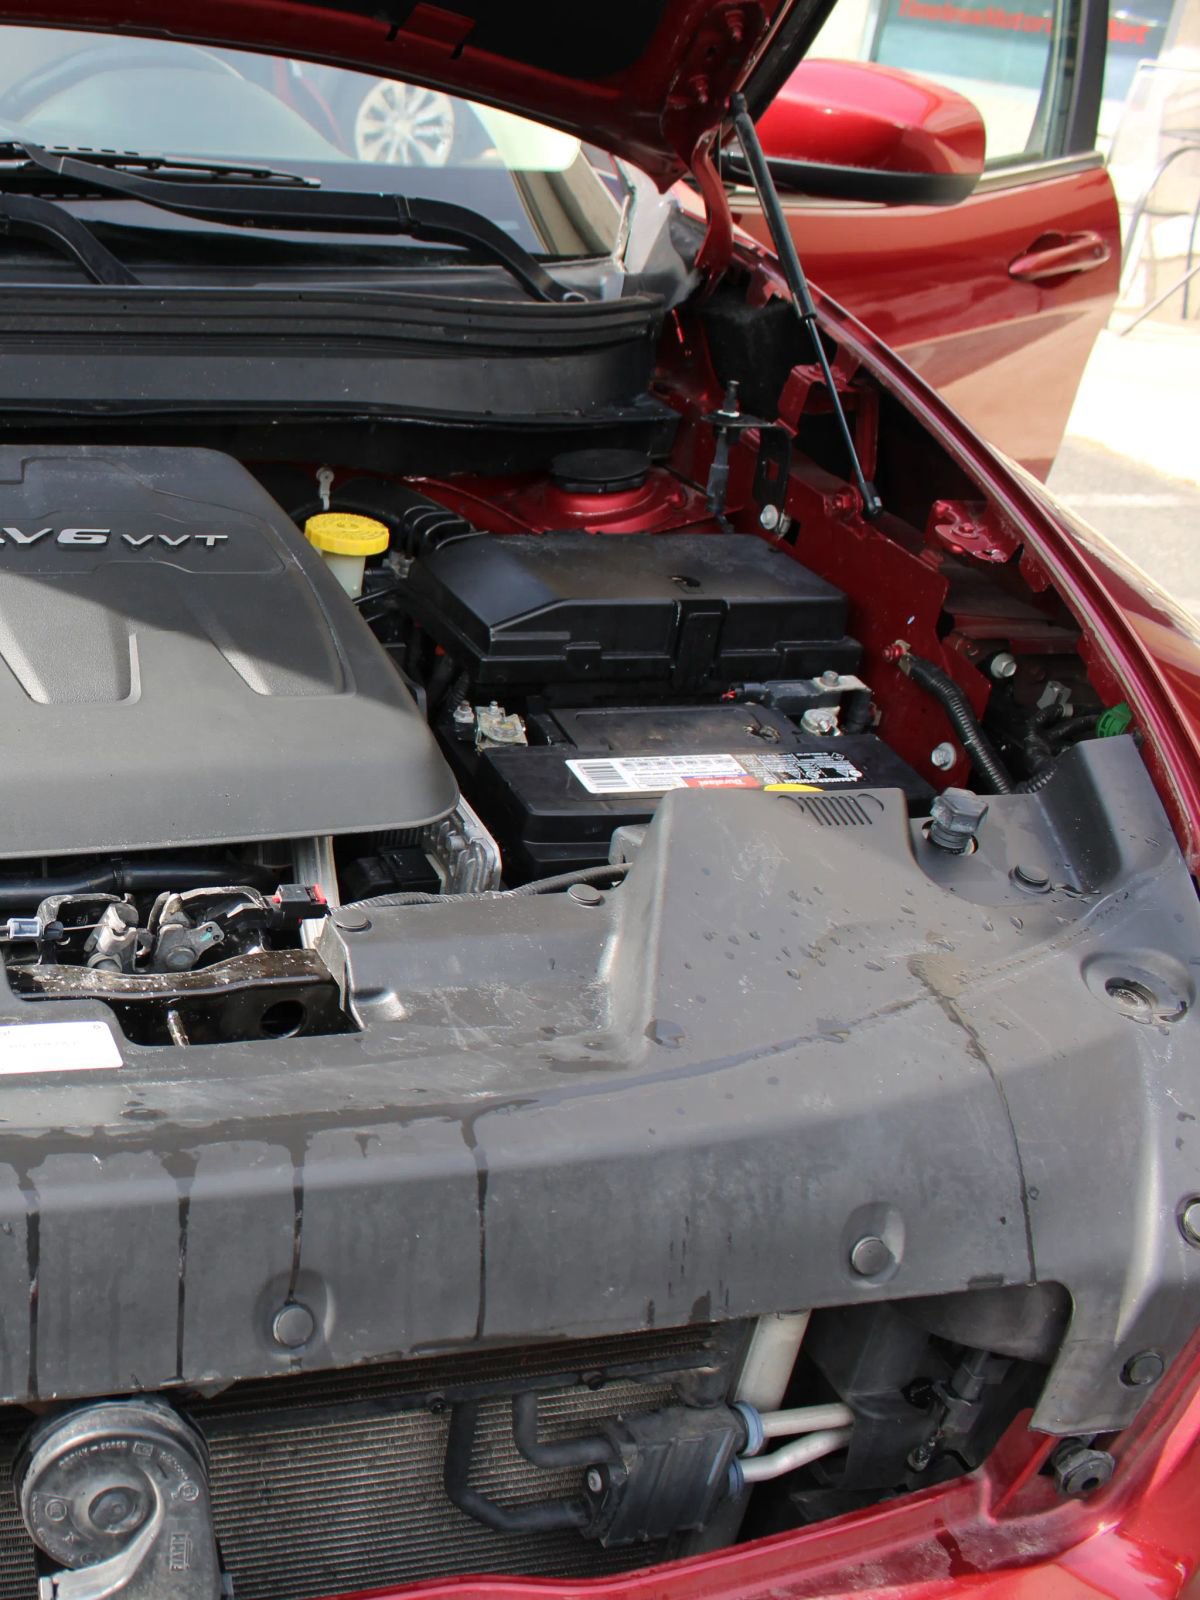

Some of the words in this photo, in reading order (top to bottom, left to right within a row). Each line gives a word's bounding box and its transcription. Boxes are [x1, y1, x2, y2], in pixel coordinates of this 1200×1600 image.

[2, 527, 110, 545] V6
[121, 533, 229, 546] VVT
[698, 778, 745, 787] Duralast
